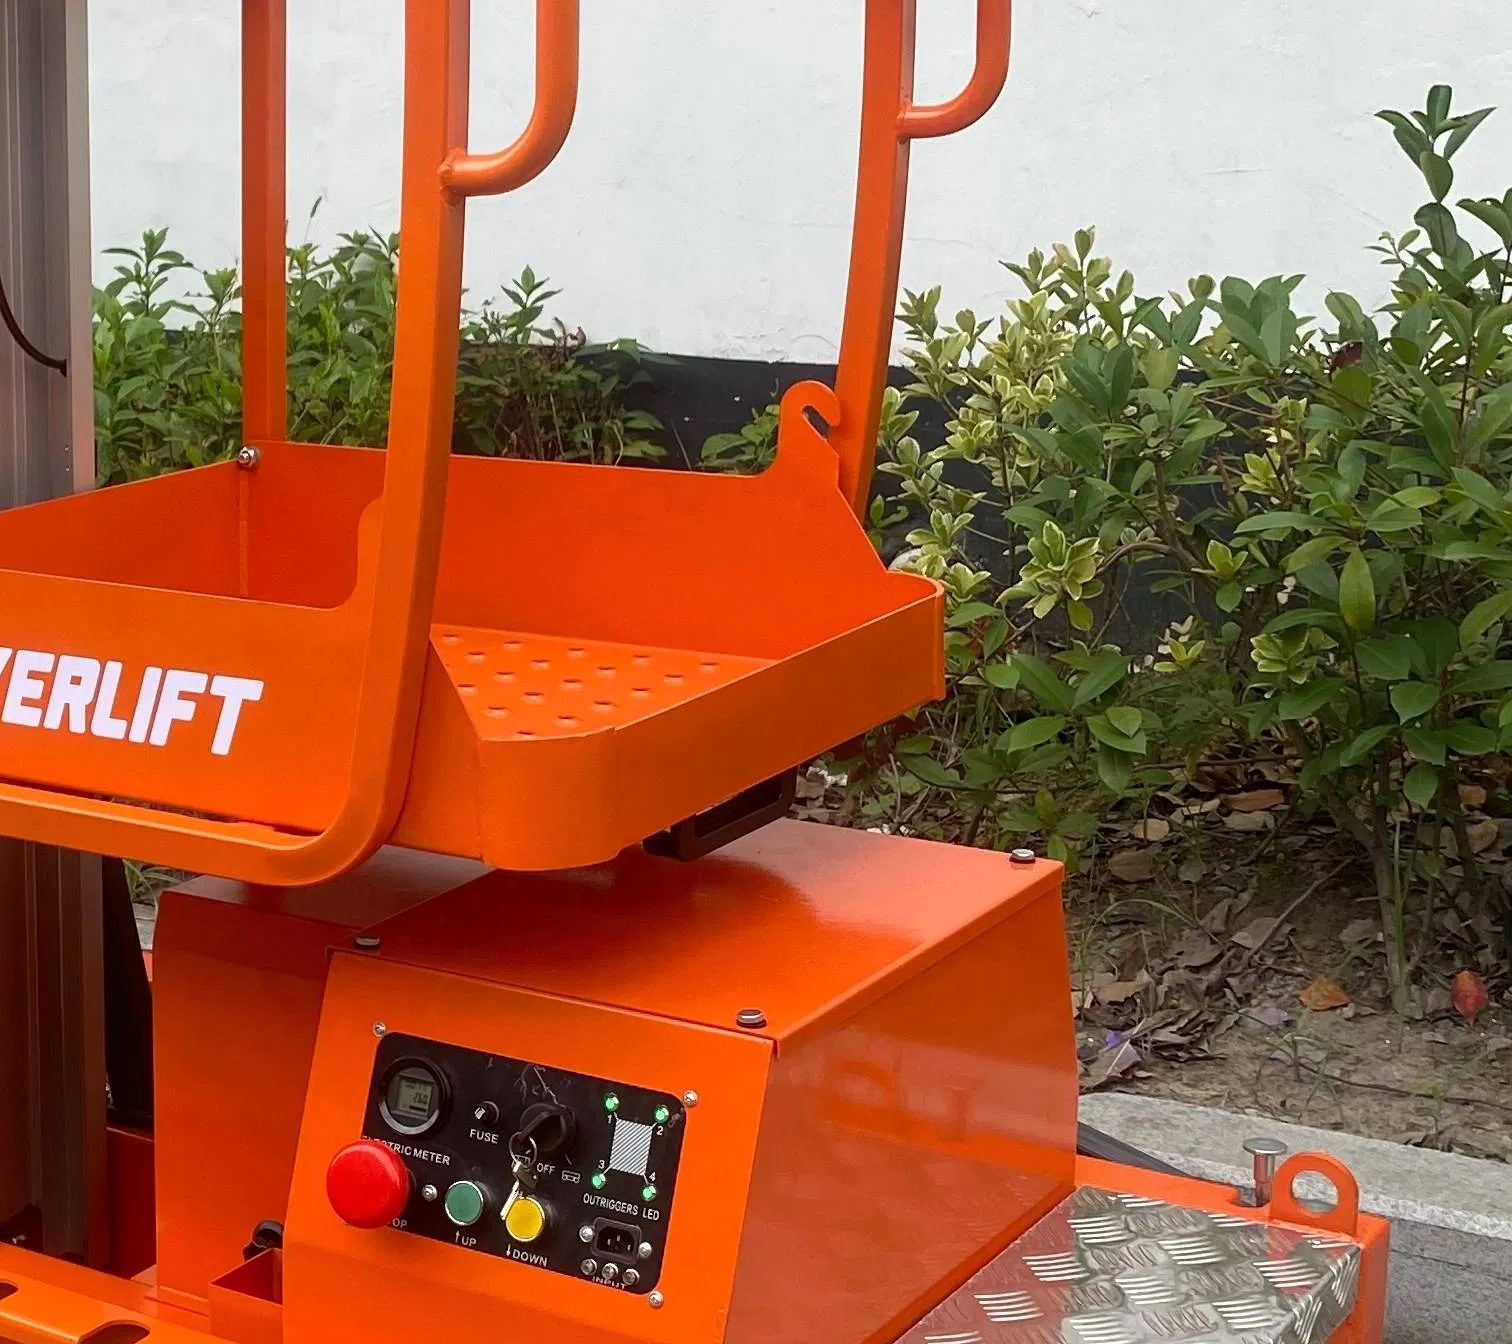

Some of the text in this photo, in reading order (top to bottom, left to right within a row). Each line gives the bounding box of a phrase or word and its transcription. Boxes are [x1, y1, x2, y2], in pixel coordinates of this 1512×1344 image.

[607, 1114, 613, 1124] 1
[469, 1128, 499, 1145] FUSE
[656, 1125, 664, 1136] 2
[413, 1147, 451, 1166] METER
[536, 1162, 556, 1175] OFF
[597, 1159, 605, 1169] 3
[648, 1171, 656, 1182] 4
[583, 1193, 660, 1221] OUTRIGGERS LED
[461, 1231, 477, 1247] UP
[512, 1249, 548, 1268] DOWN
